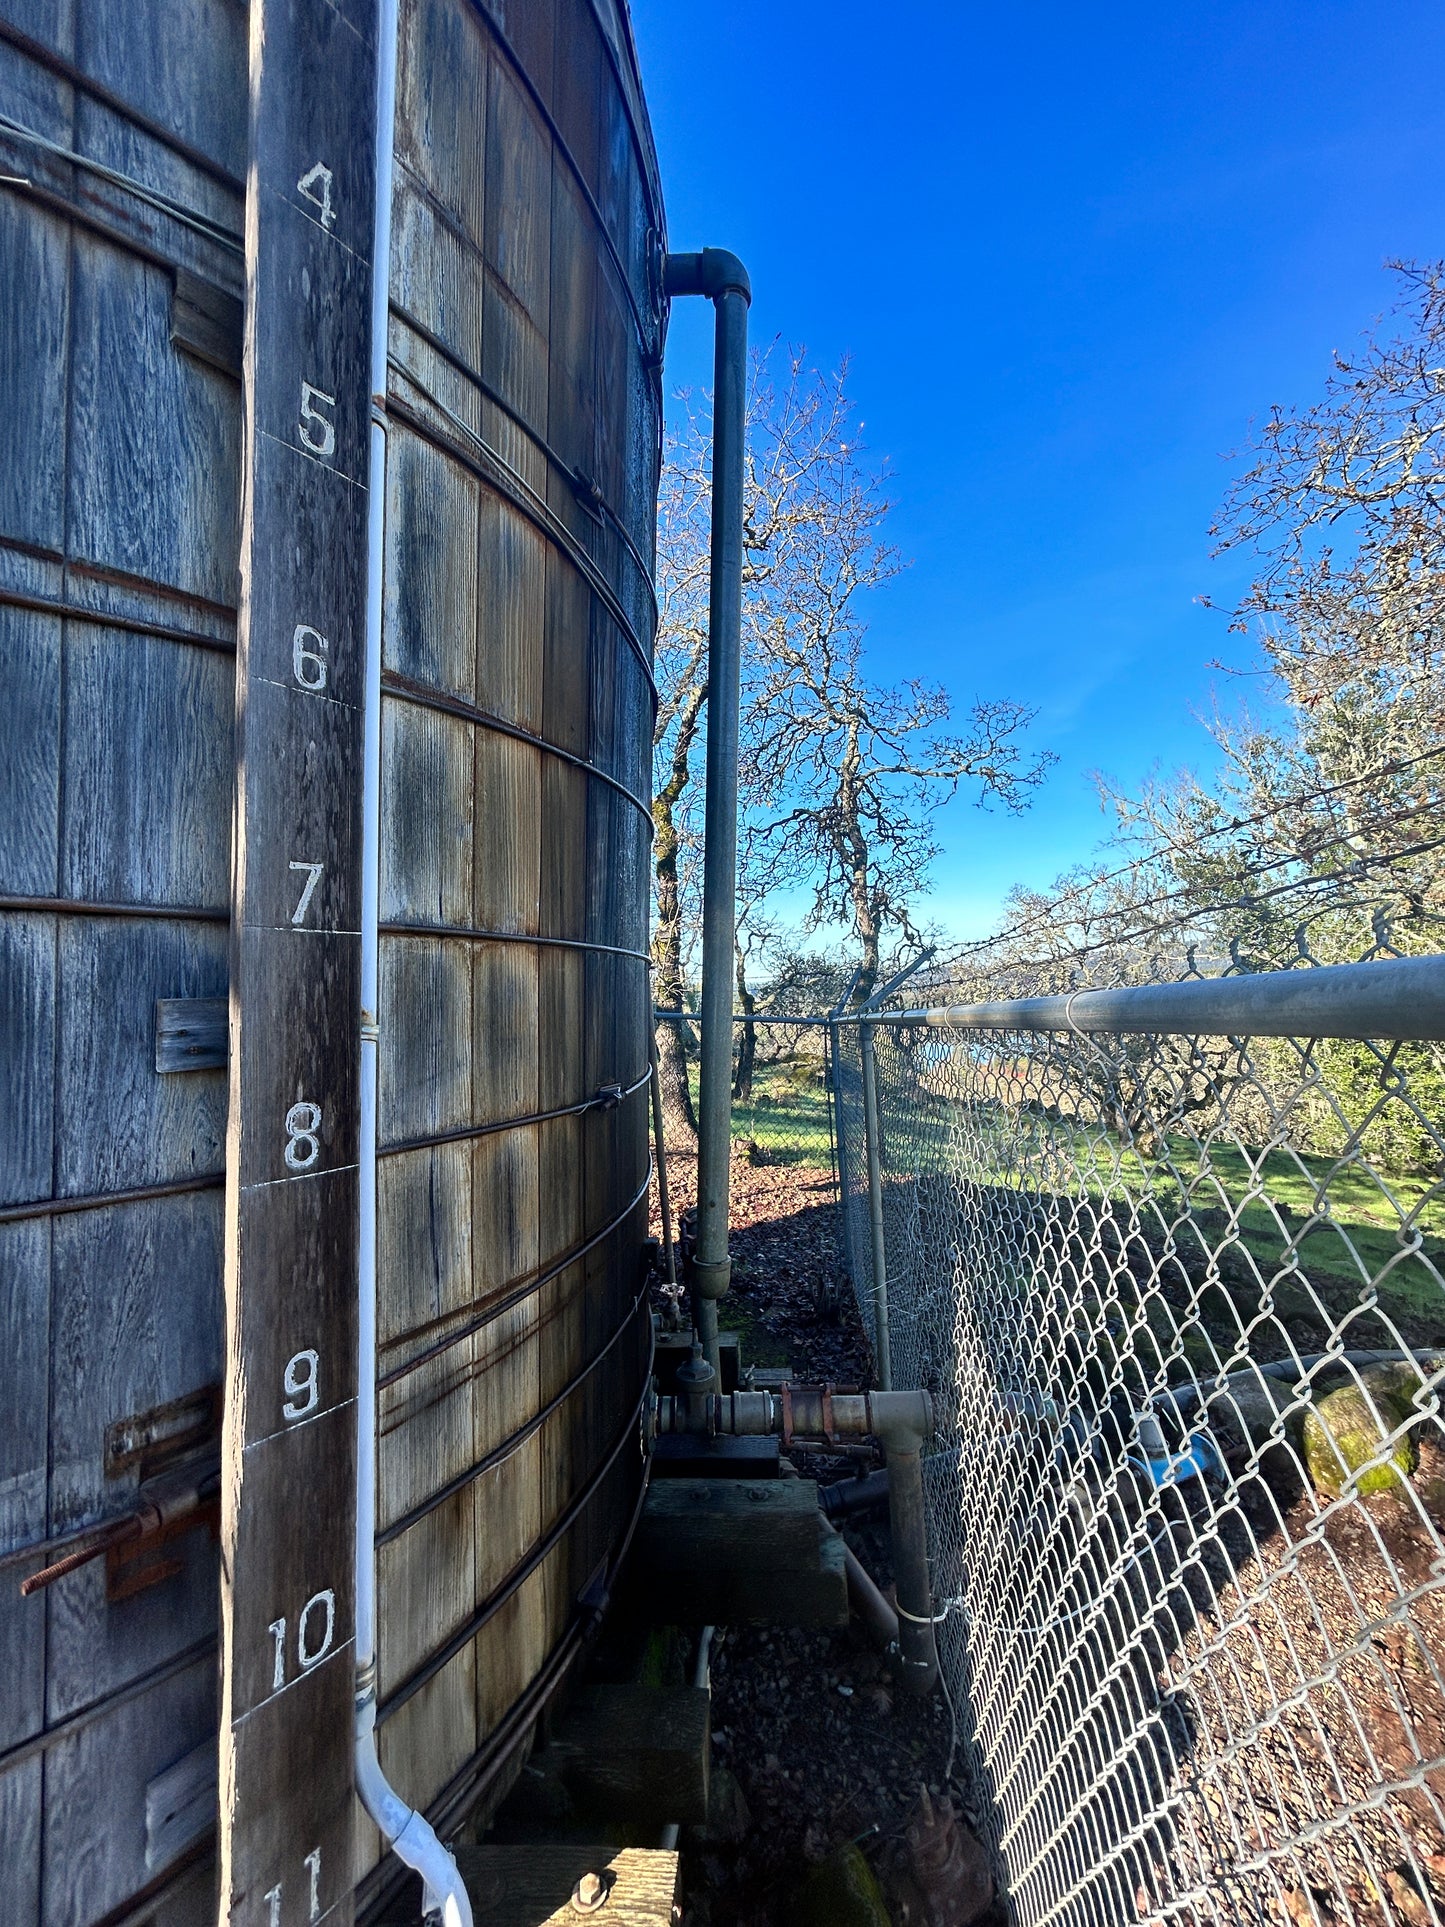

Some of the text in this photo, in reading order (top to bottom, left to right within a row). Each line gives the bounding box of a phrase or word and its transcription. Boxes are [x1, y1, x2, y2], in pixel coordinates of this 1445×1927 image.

[297, 161, 337, 228] 4
[298, 382, 335, 455] 5
[292, 624, 329, 690] 6
[288, 861, 324, 924] 7
[284, 1101, 322, 1169] 8
[282, 1348, 319, 1420] 9
[267, 1588, 335, 1689] 10
